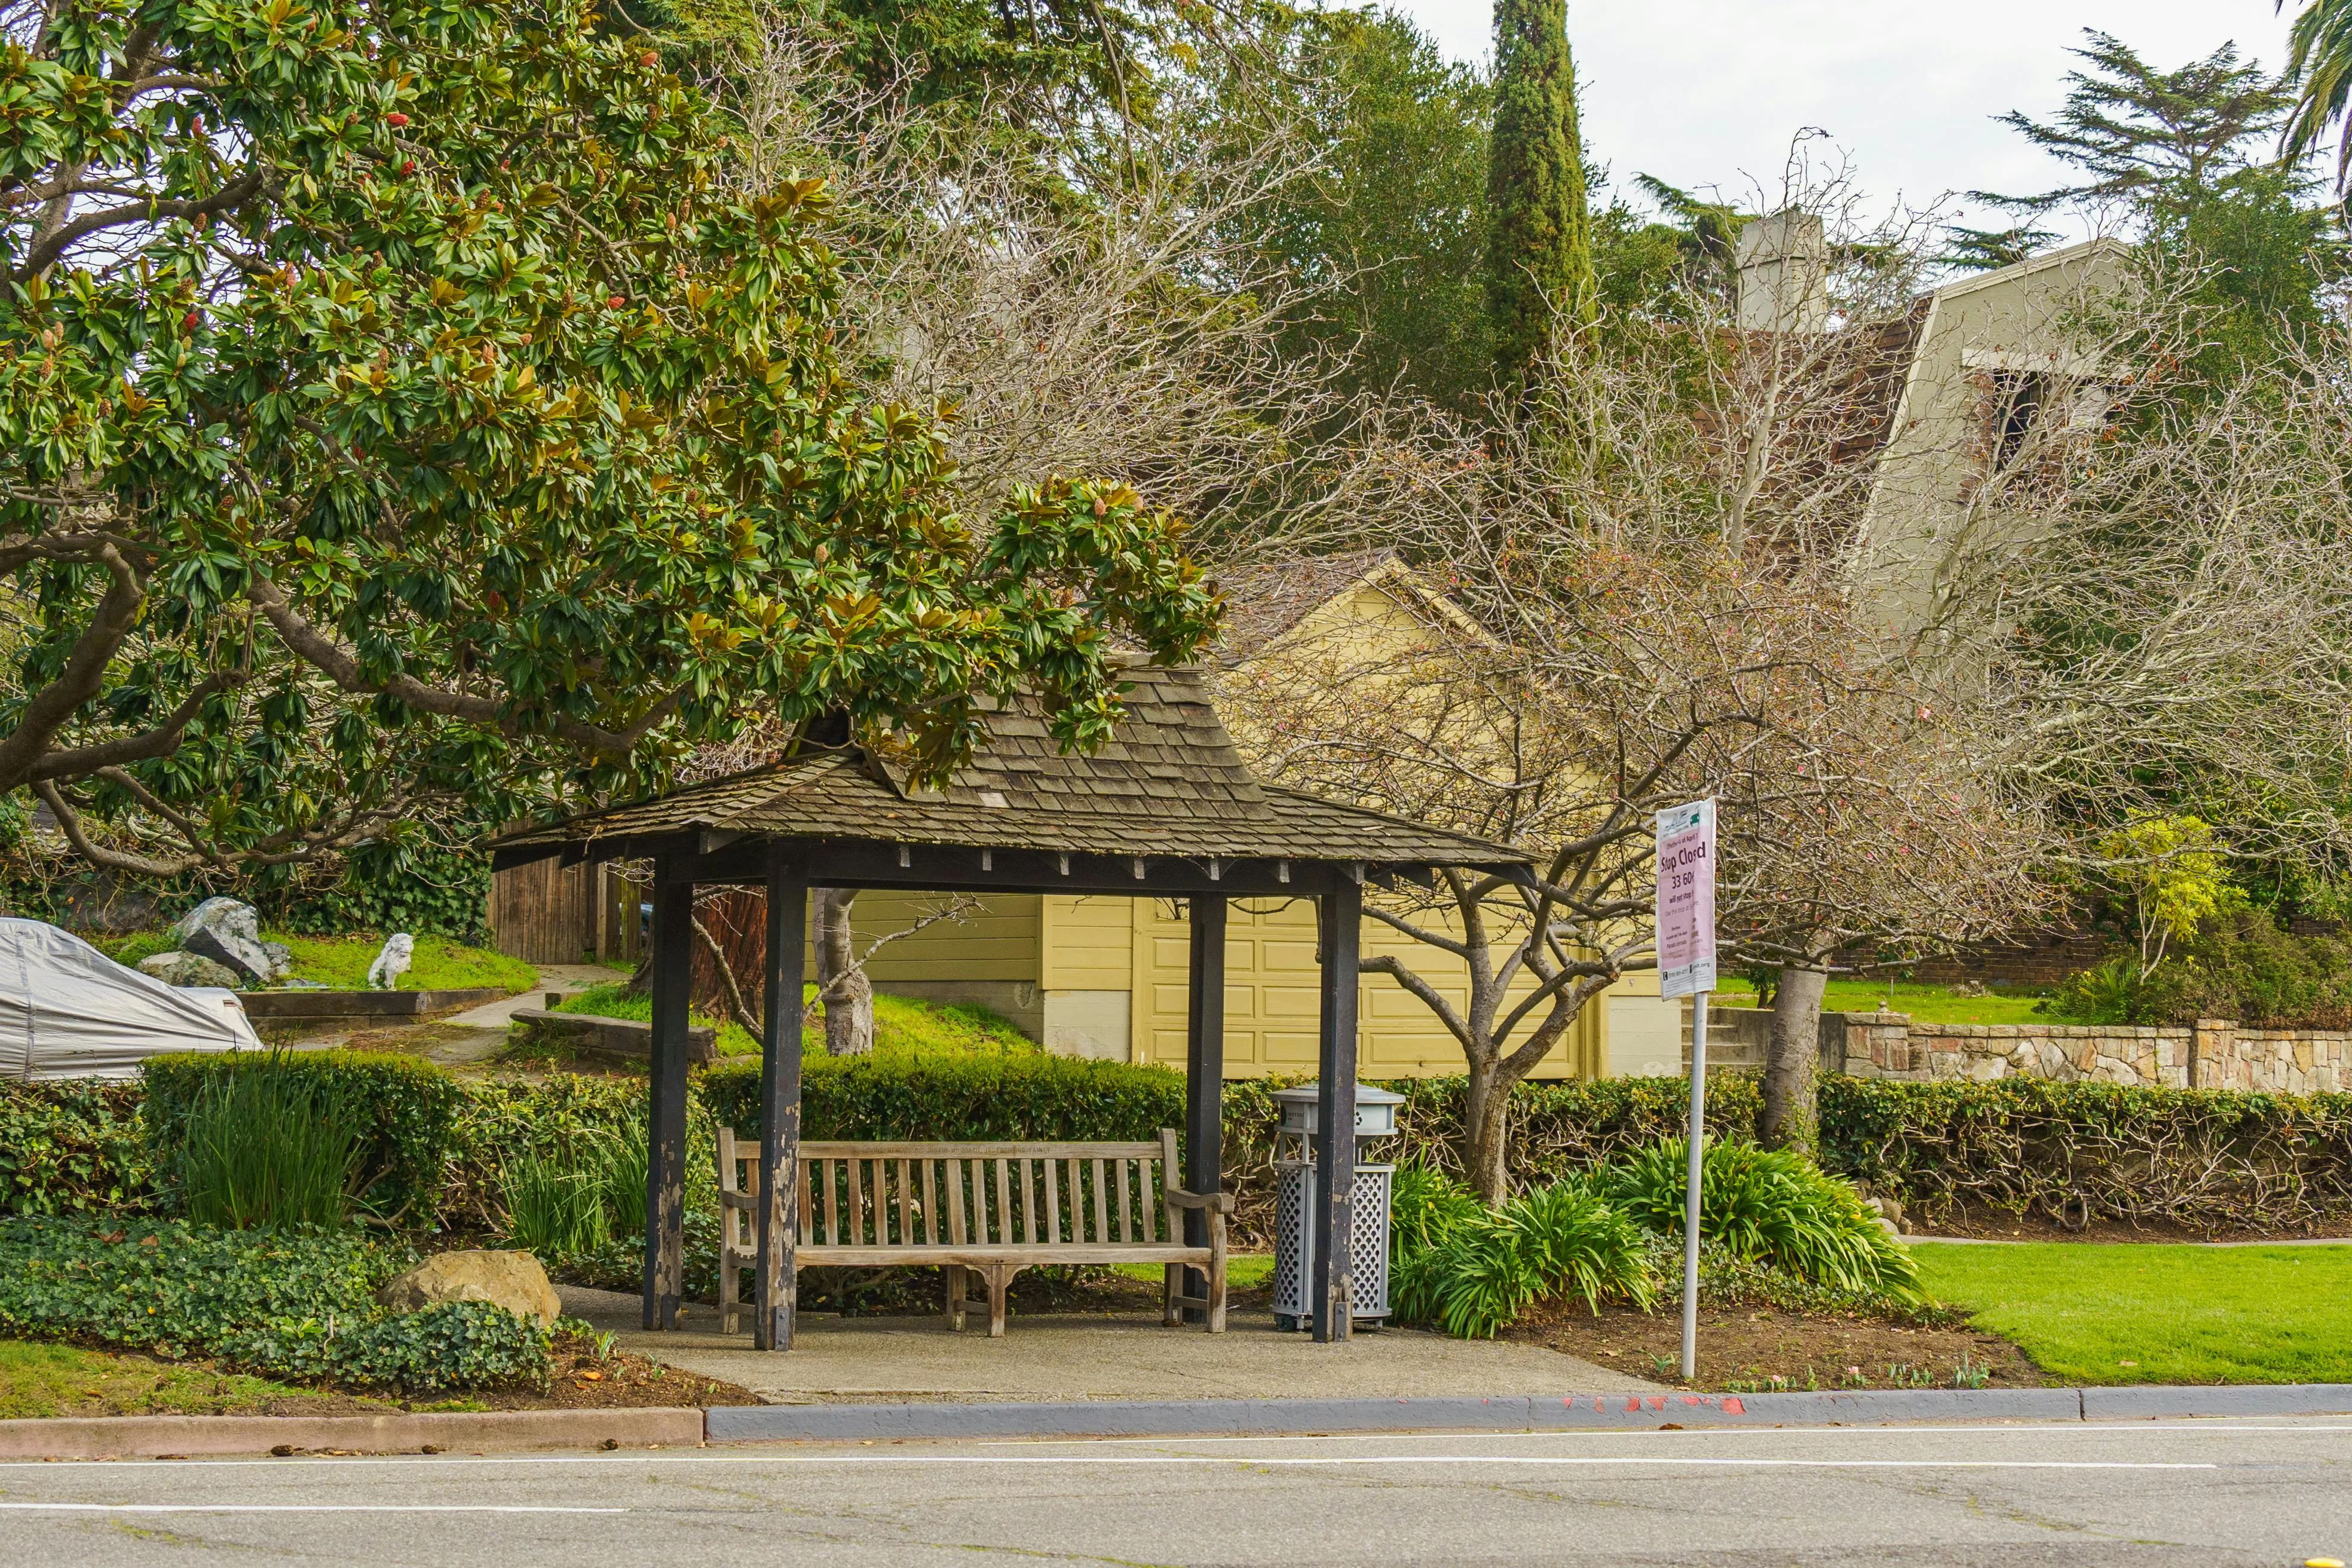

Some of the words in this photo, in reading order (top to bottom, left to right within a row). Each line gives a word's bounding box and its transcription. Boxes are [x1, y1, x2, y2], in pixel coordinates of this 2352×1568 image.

[1661, 856, 1677, 873] Stop
[1679, 841, 1706, 865] Closd
[1671, 875, 1681, 889] 33
